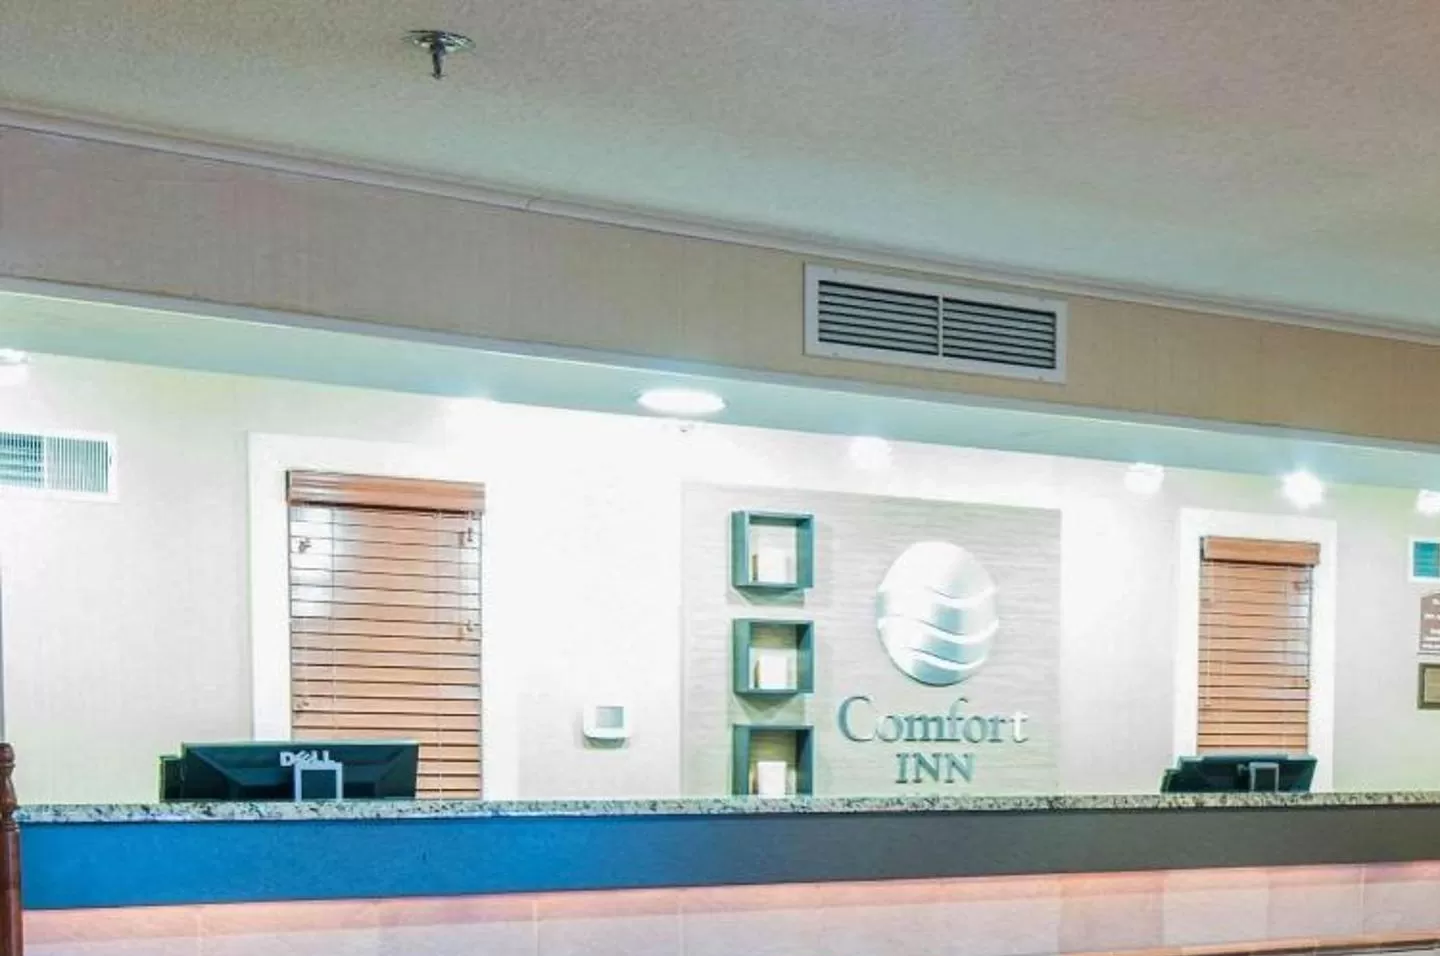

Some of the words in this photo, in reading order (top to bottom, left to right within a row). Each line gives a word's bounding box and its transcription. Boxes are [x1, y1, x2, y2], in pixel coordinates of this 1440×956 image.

[838, 696, 1031, 743] Comfort
[280, 750, 336, 767] DELL
[895, 752, 974, 784] INN
